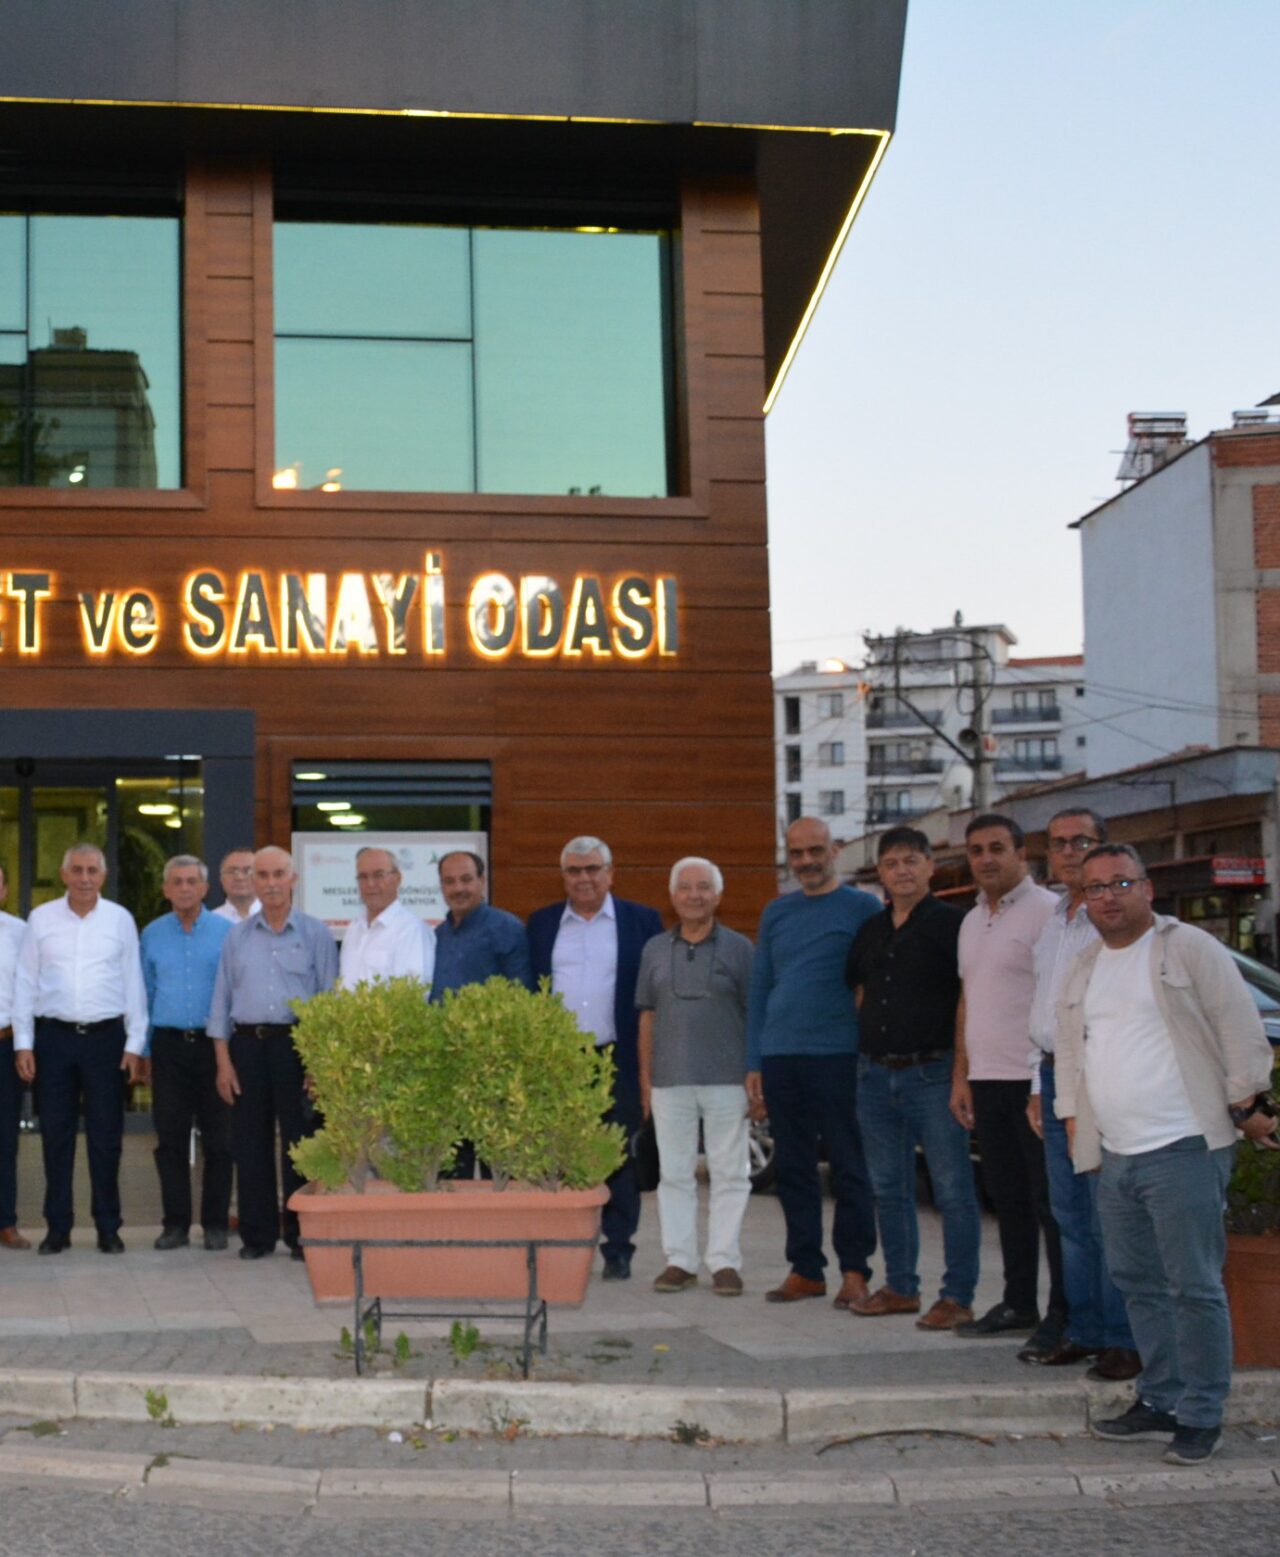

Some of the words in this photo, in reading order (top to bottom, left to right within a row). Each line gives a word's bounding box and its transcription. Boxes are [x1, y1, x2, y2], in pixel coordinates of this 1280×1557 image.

[77, 588, 160, 656] ve
[183, 551, 445, 656] SANAYİ
[468, 572, 680, 658] ODASI
